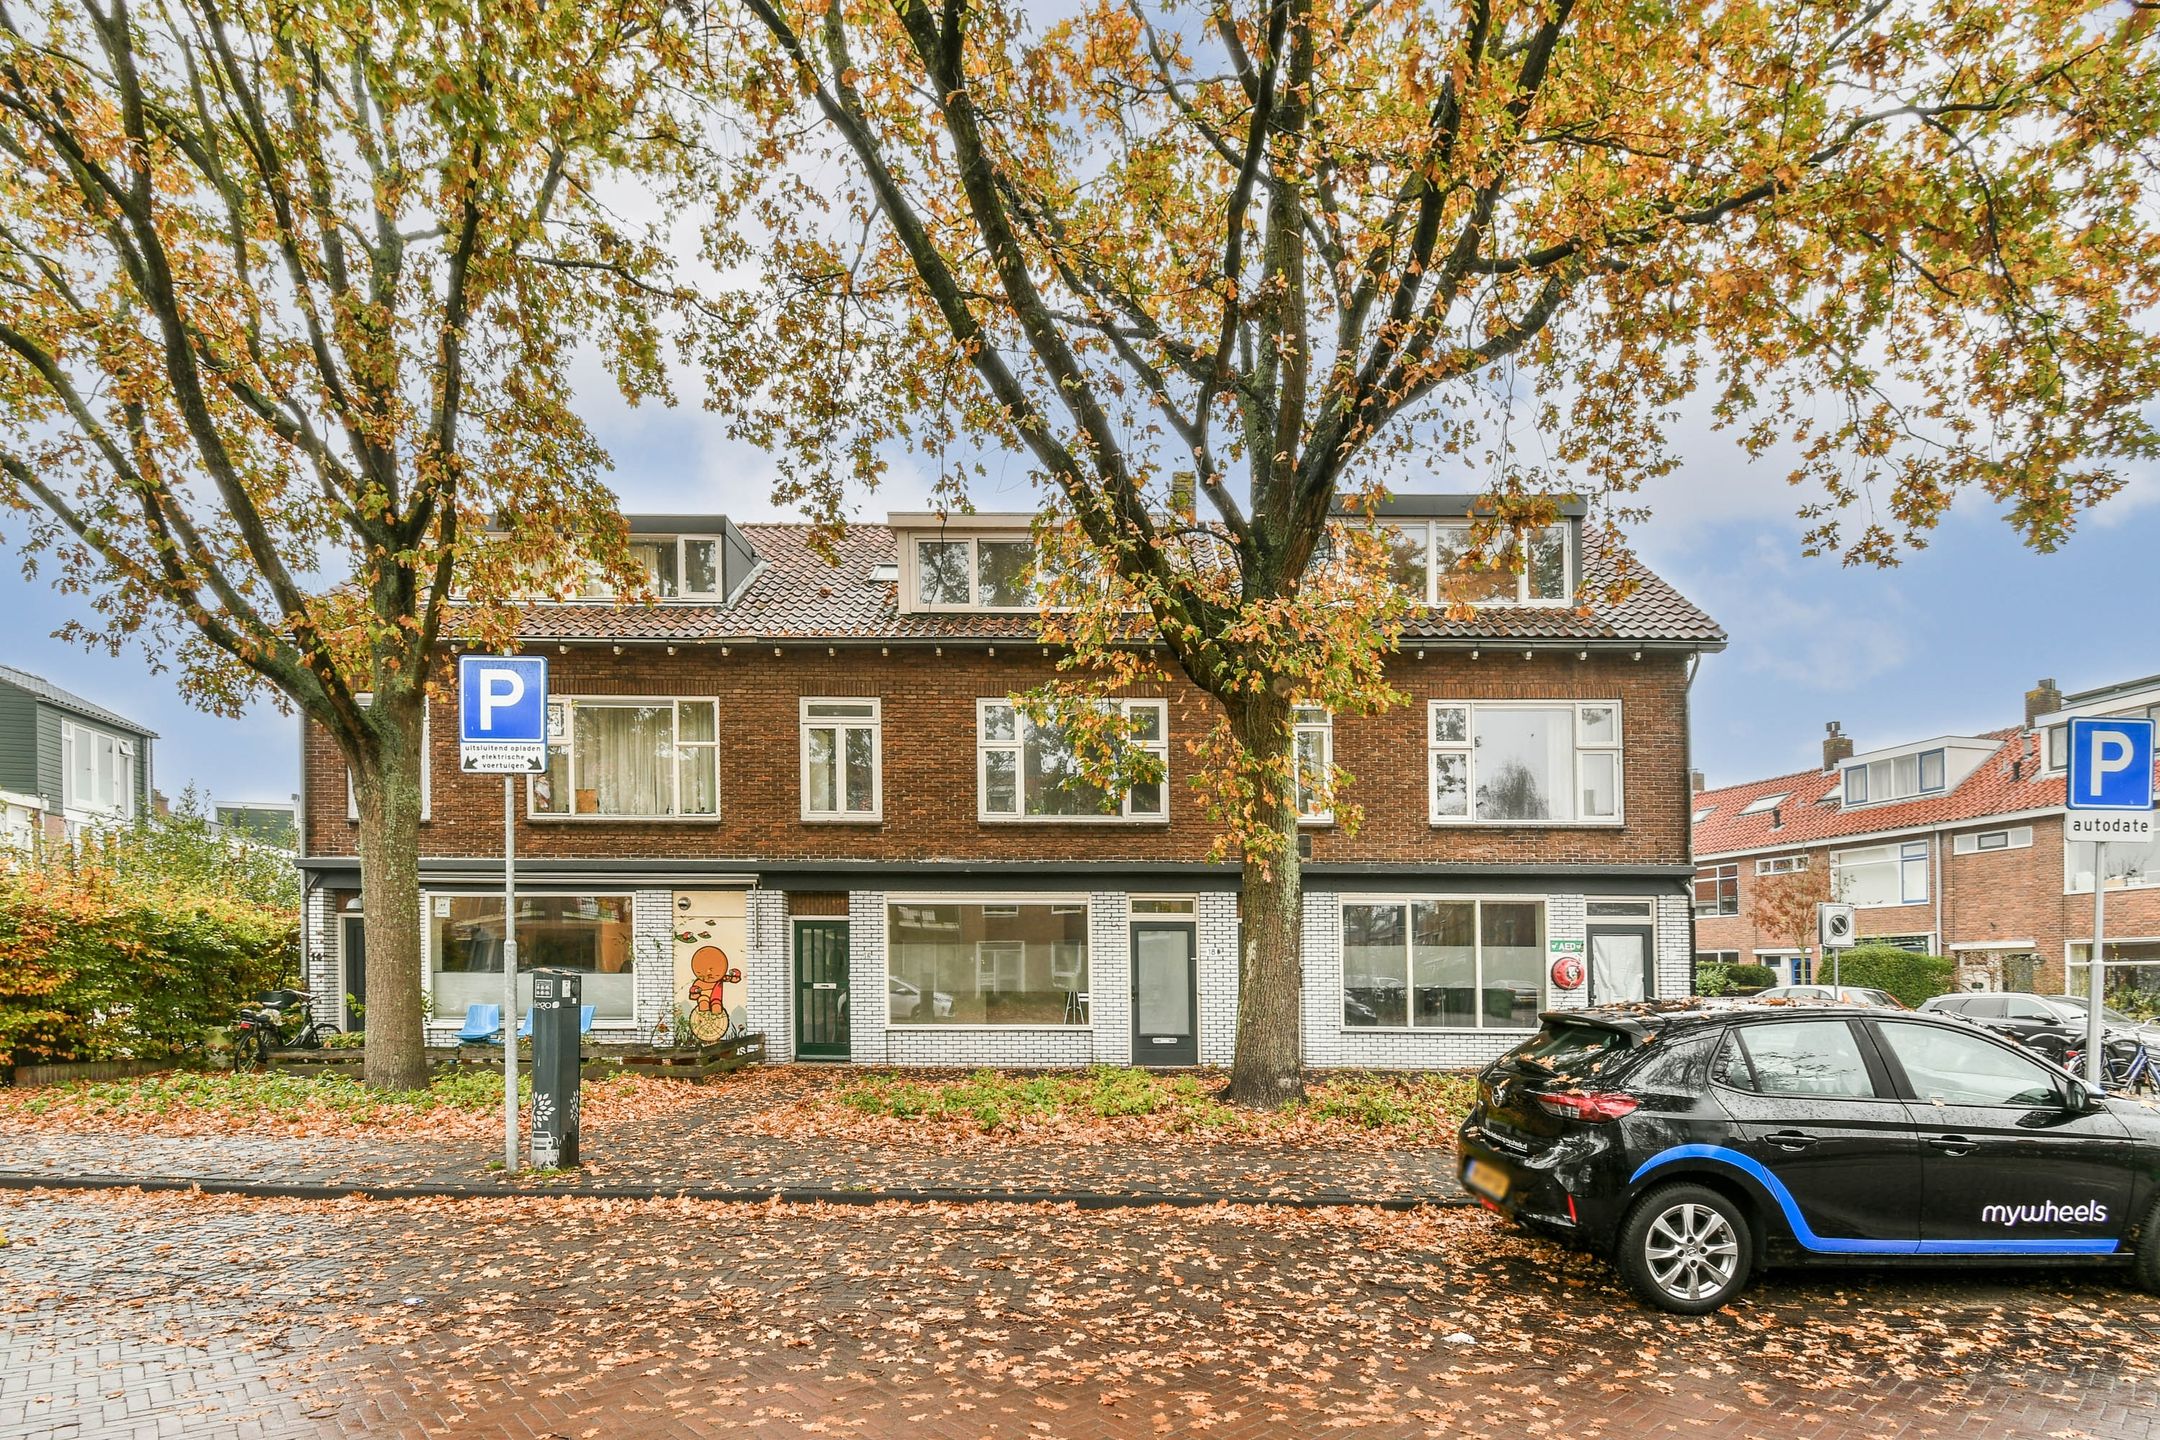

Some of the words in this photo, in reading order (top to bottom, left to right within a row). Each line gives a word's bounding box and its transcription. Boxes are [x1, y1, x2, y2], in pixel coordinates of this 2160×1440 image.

[479, 668, 525, 731] P
[465, 743, 508, 752] uitsluitend
[510, 743, 541, 753] opladen
[481, 753, 525, 761] elektrische
[482, 762, 525, 770] voertuigen
[2089, 730, 2134, 797] P
[2073, 818, 2149, 833] autodate
[1558, 942, 1576, 951] AED
[1981, 1199, 2108, 1227] mywheels
